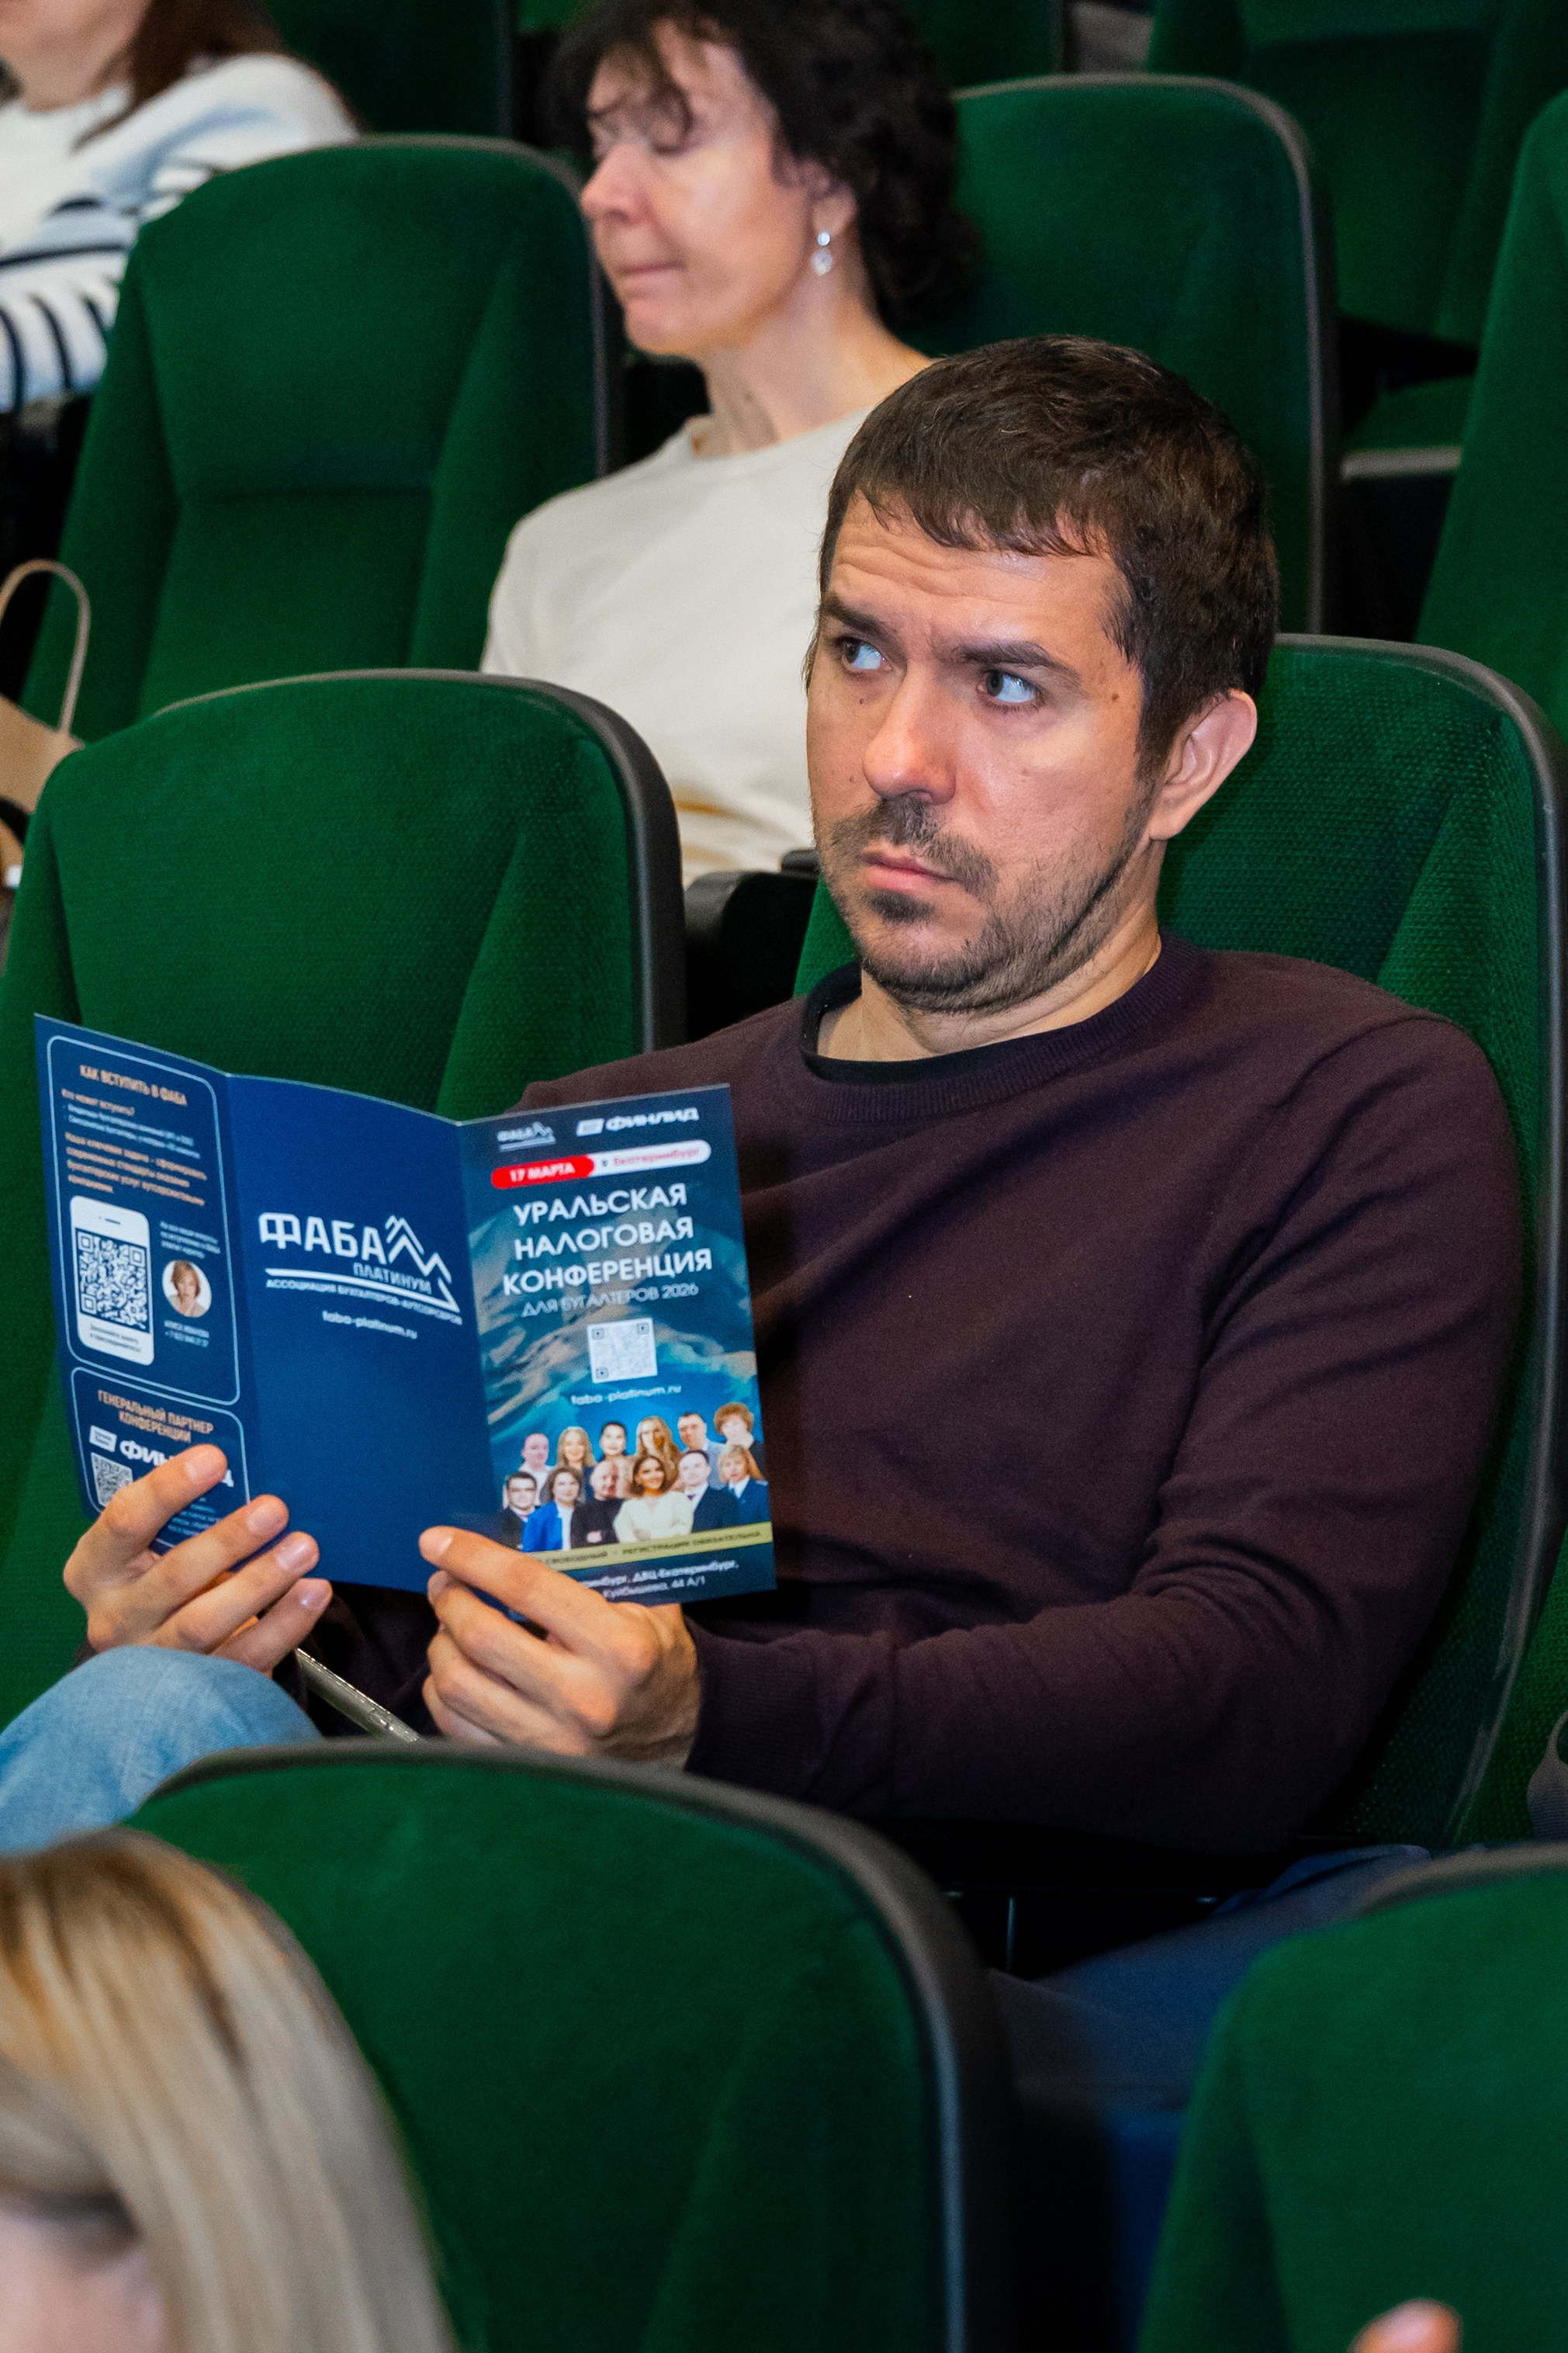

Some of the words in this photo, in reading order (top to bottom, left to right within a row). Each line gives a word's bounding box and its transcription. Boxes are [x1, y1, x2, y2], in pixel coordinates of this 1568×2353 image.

[509, 1169, 526, 1183] 17
[528, 1162, 576, 1181] МАРТА
[513, 1183, 687, 1227] УРАЛЬСКАЯ
[258, 1211, 387, 1266] ФАБА
[514, 1216, 694, 1261] НАЛОГОВАЯ
[353, 1262, 432, 1295] ПЛАТИНУМ
[502, 1248, 712, 1296] КОНФЕРЕНЦИЯ
[521, 1300, 559, 1319] ДЛЯ
[662, 1282, 699, 1299] 2026
